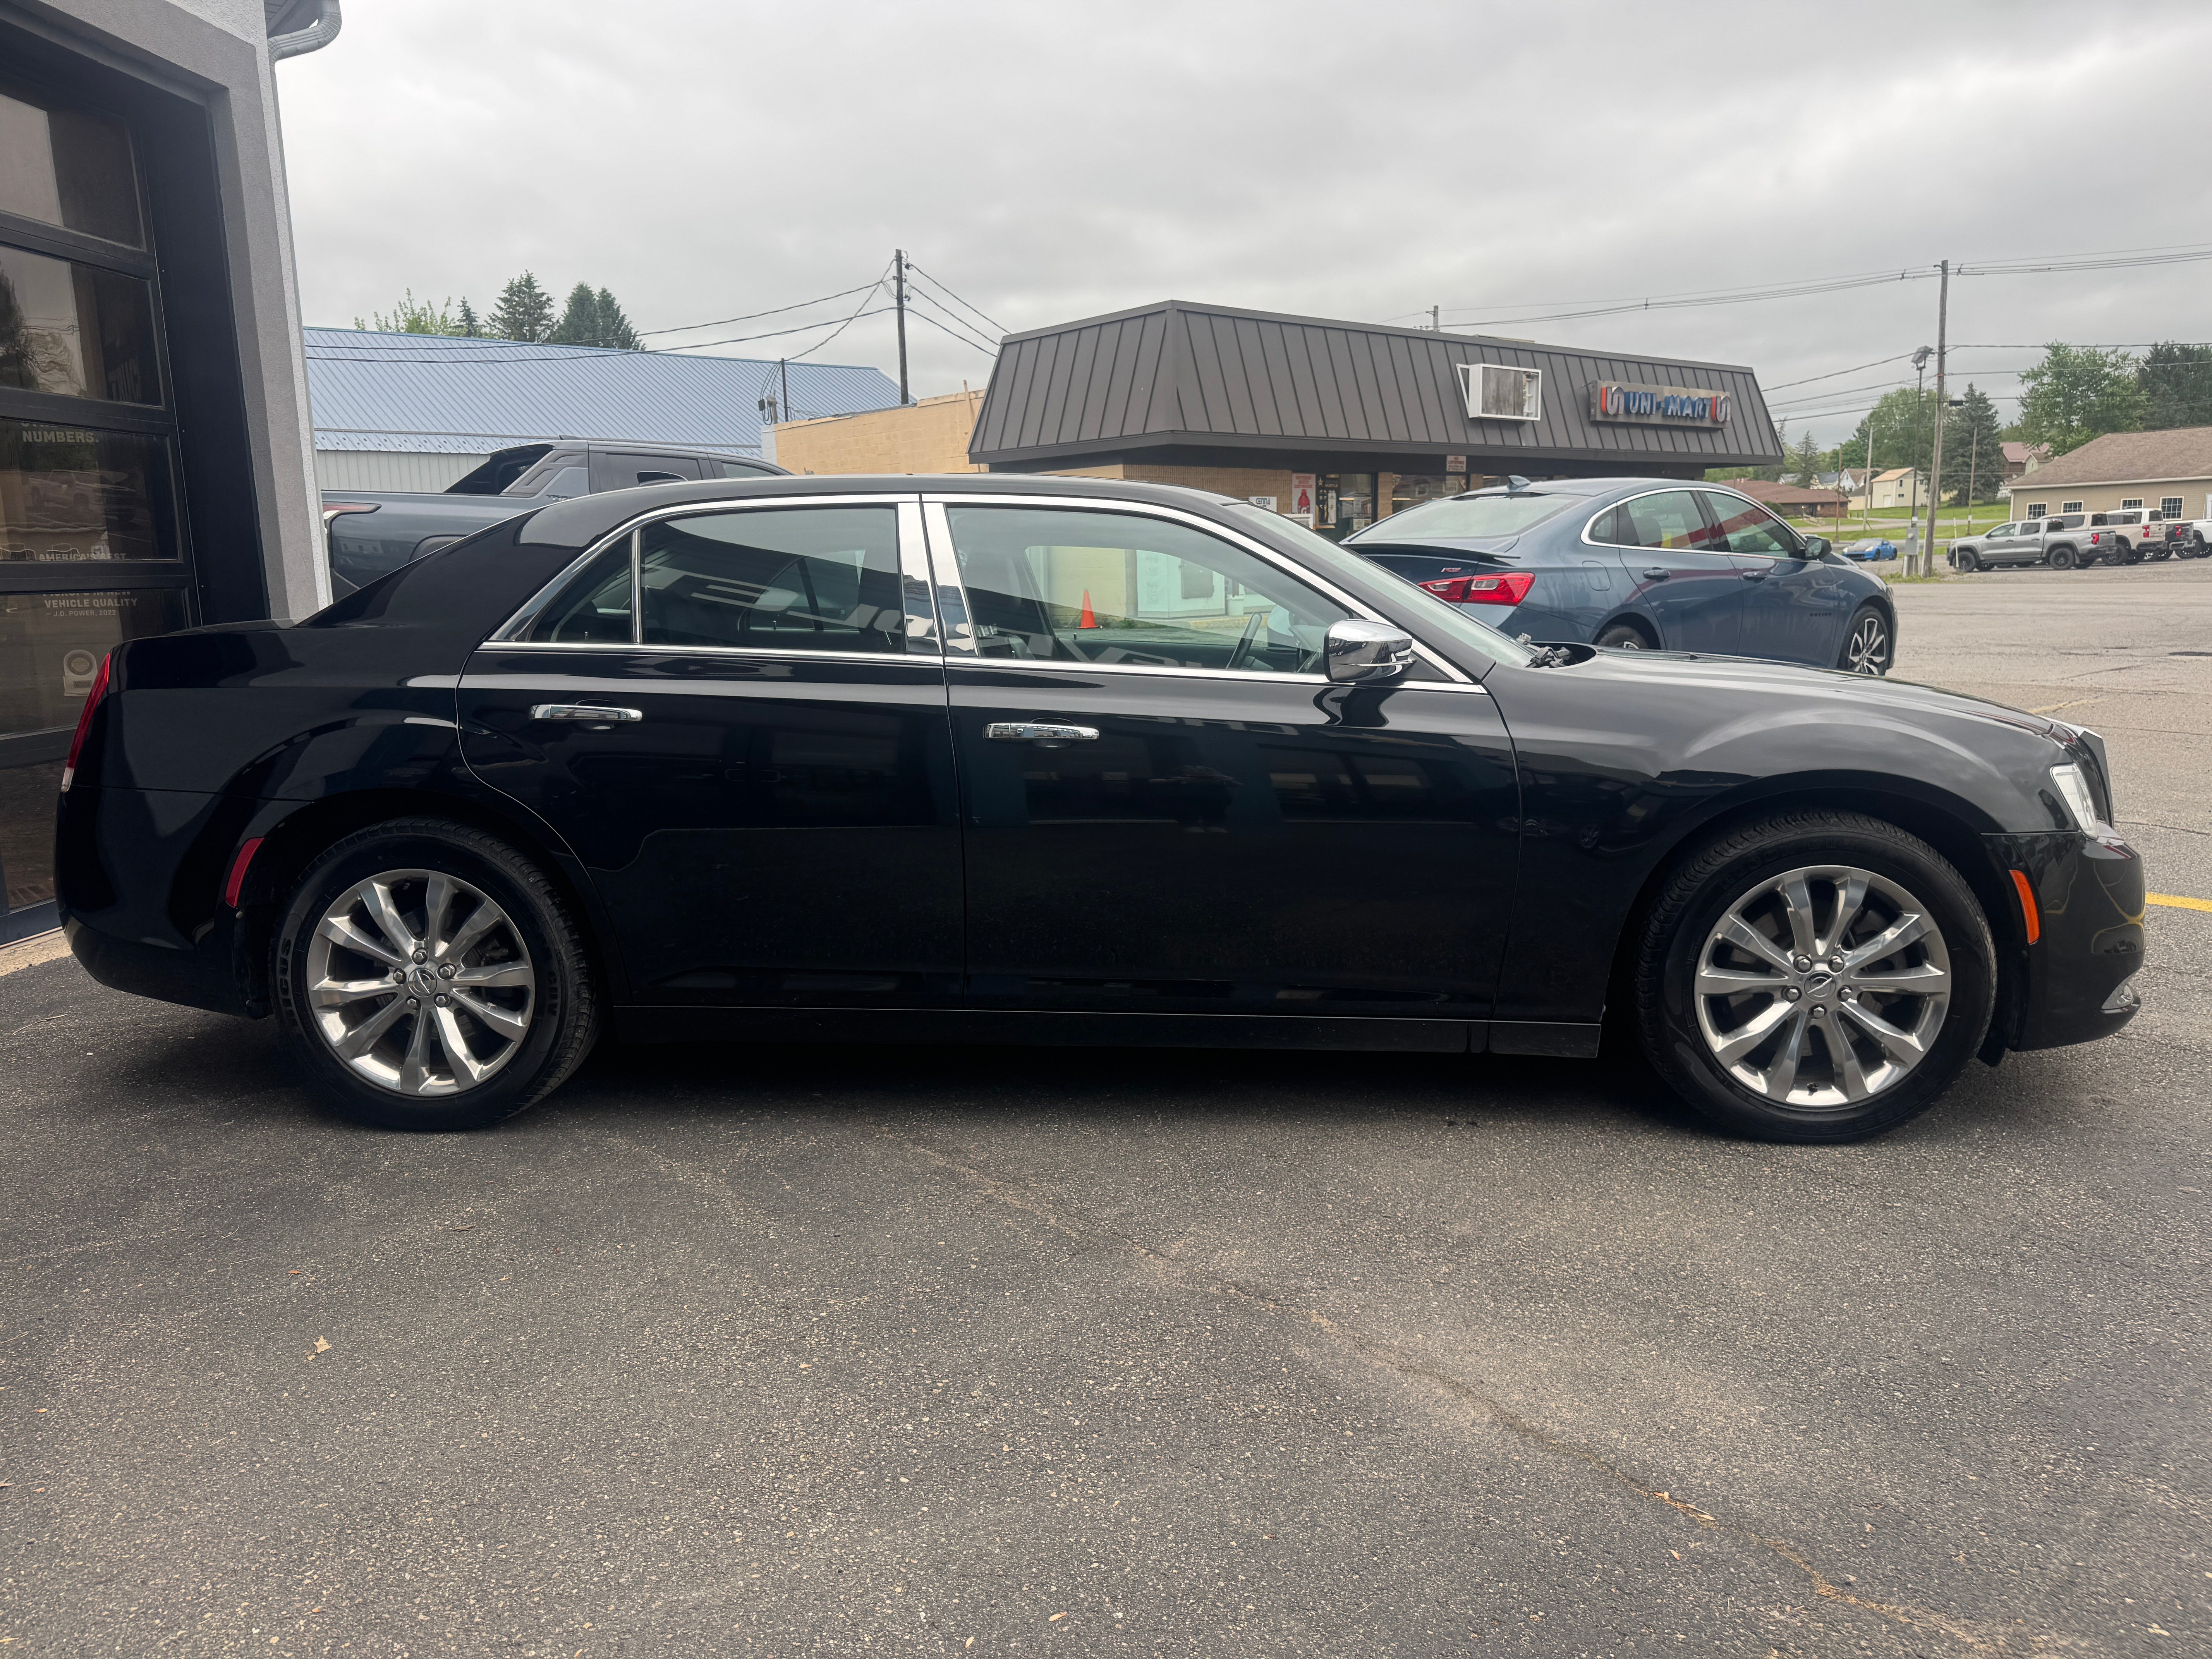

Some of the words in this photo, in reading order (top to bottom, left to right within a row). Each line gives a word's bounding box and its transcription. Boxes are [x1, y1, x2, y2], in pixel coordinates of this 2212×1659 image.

[1625, 391, 1711, 419] UNI-MART
[22, 431, 99, 443] NUMBERS.
[44, 599, 89, 608] VEHICLE
[93, 598, 137, 607] QUALITY
